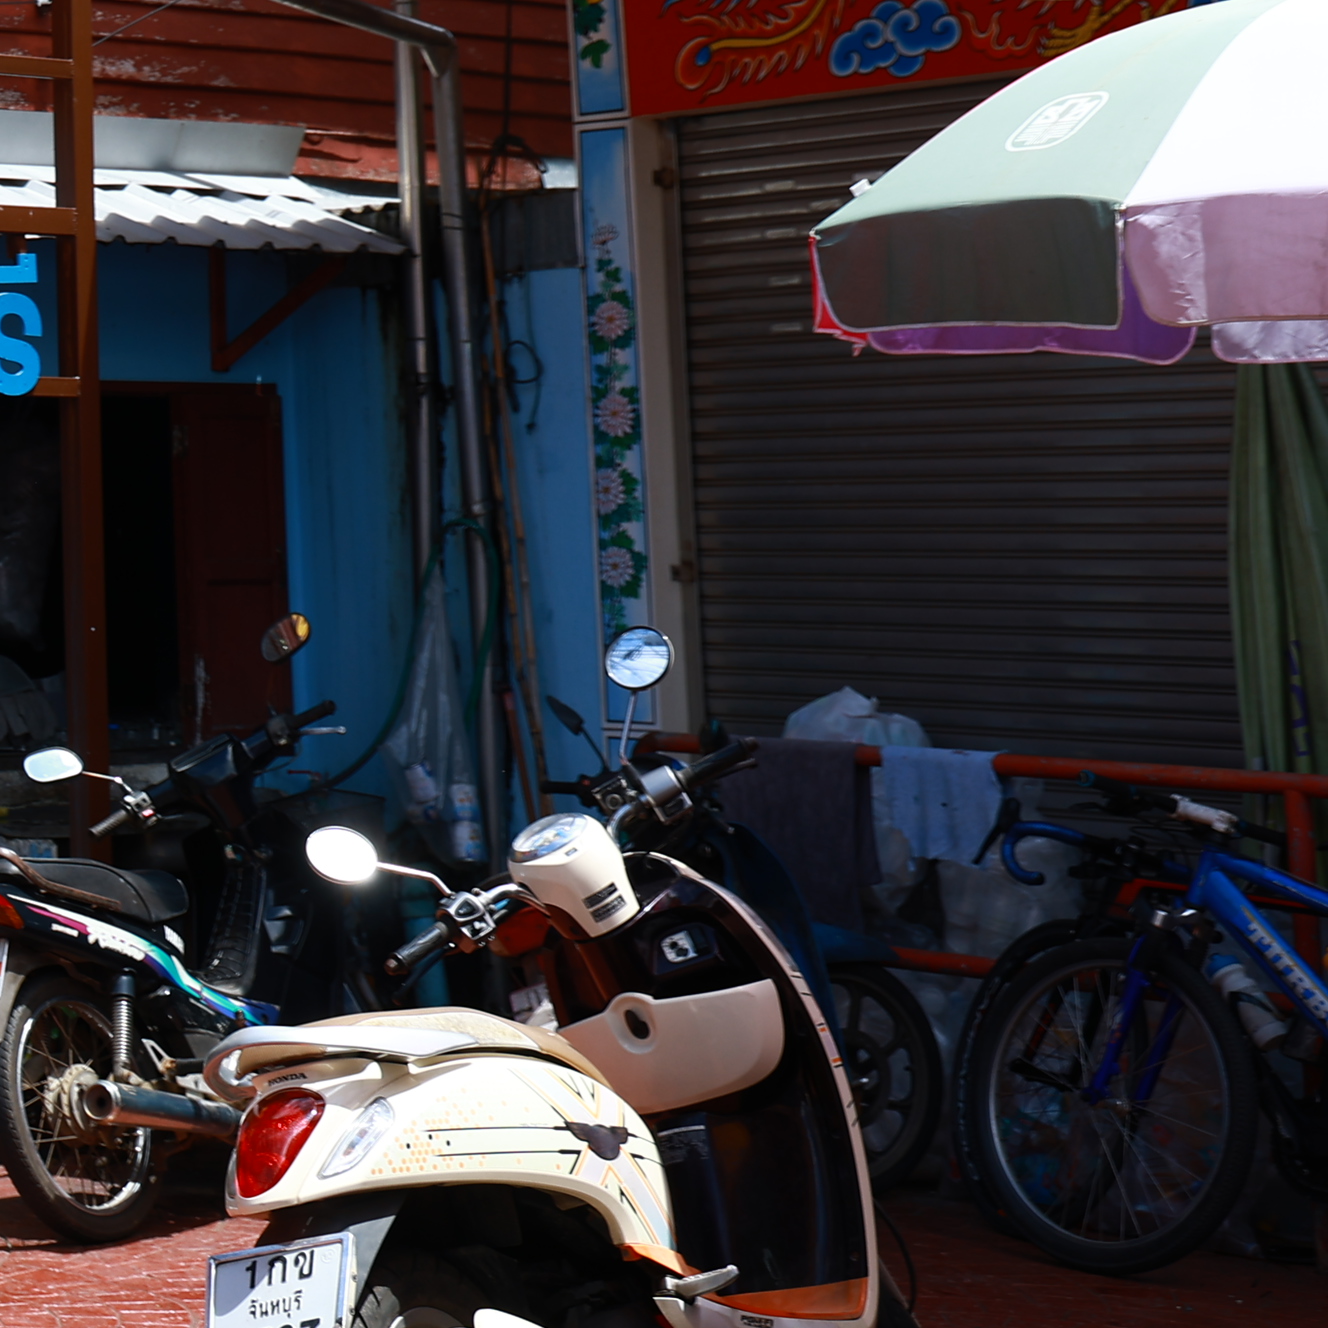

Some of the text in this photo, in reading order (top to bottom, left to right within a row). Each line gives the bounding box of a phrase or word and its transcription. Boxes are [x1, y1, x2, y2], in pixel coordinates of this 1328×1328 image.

[1245, 919, 1328, 1030] TURB
[248, 1289, 304, 1320] จันทบุรี
